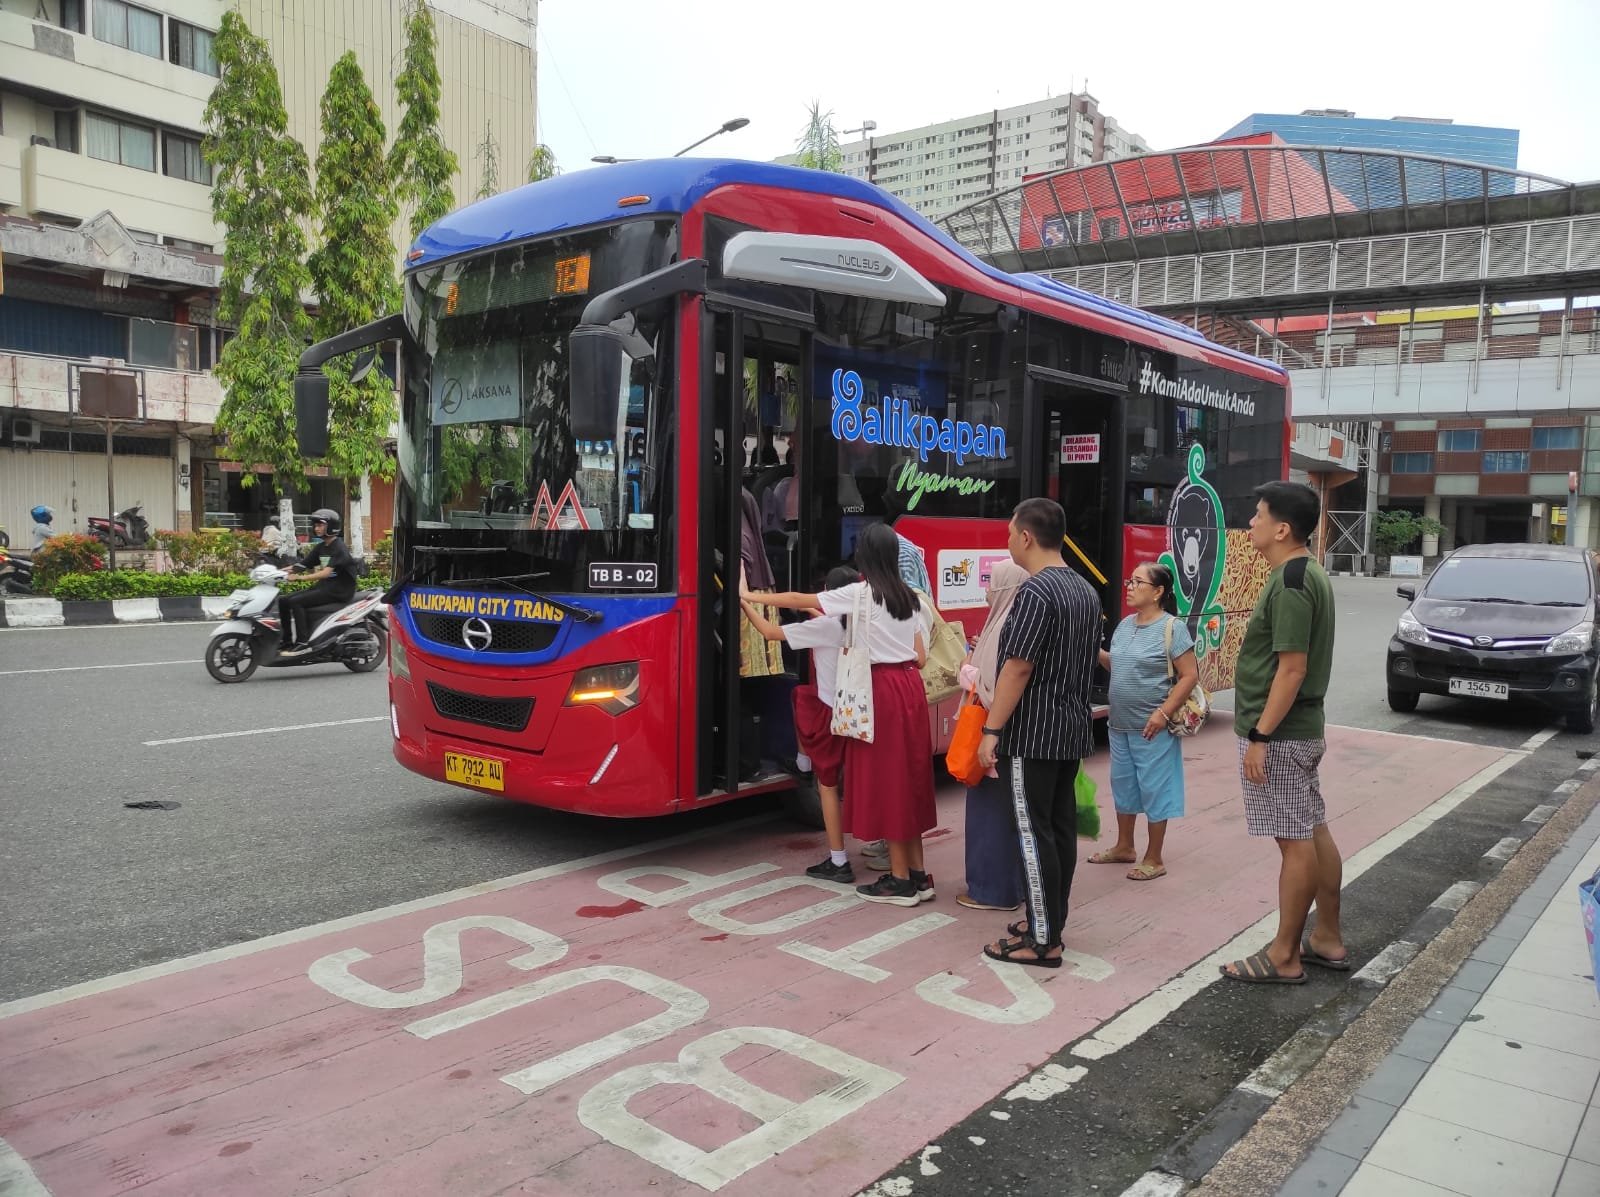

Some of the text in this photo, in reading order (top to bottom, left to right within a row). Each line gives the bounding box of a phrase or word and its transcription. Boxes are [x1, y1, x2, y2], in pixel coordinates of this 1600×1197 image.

[838, 254, 880, 270] NUCLEUS
[466, 384, 512, 401] LAKSANA
[1139, 361, 1255, 416] #KamiAdaUntukAnda
[832, 368, 1006, 466] Balikpapan
[1075, 453, 1093, 461] PINTU
[896, 459, 995, 511] Nyaman
[636, 569, 654, 582] 02
[410, 592, 565, 622] BALIKPAPAN CITY TRANS
[1450, 680, 1462, 689] KT
[1494, 684, 1507, 694] ZD
[446, 755, 501, 780] KT 7912 AU
[1028, 861, 1040, 888] VICTORY
[1033, 890, 1044, 917] THROUGH
[1037, 919, 1046, 938] UNITY
[307, 914, 907, 1193] BUS
